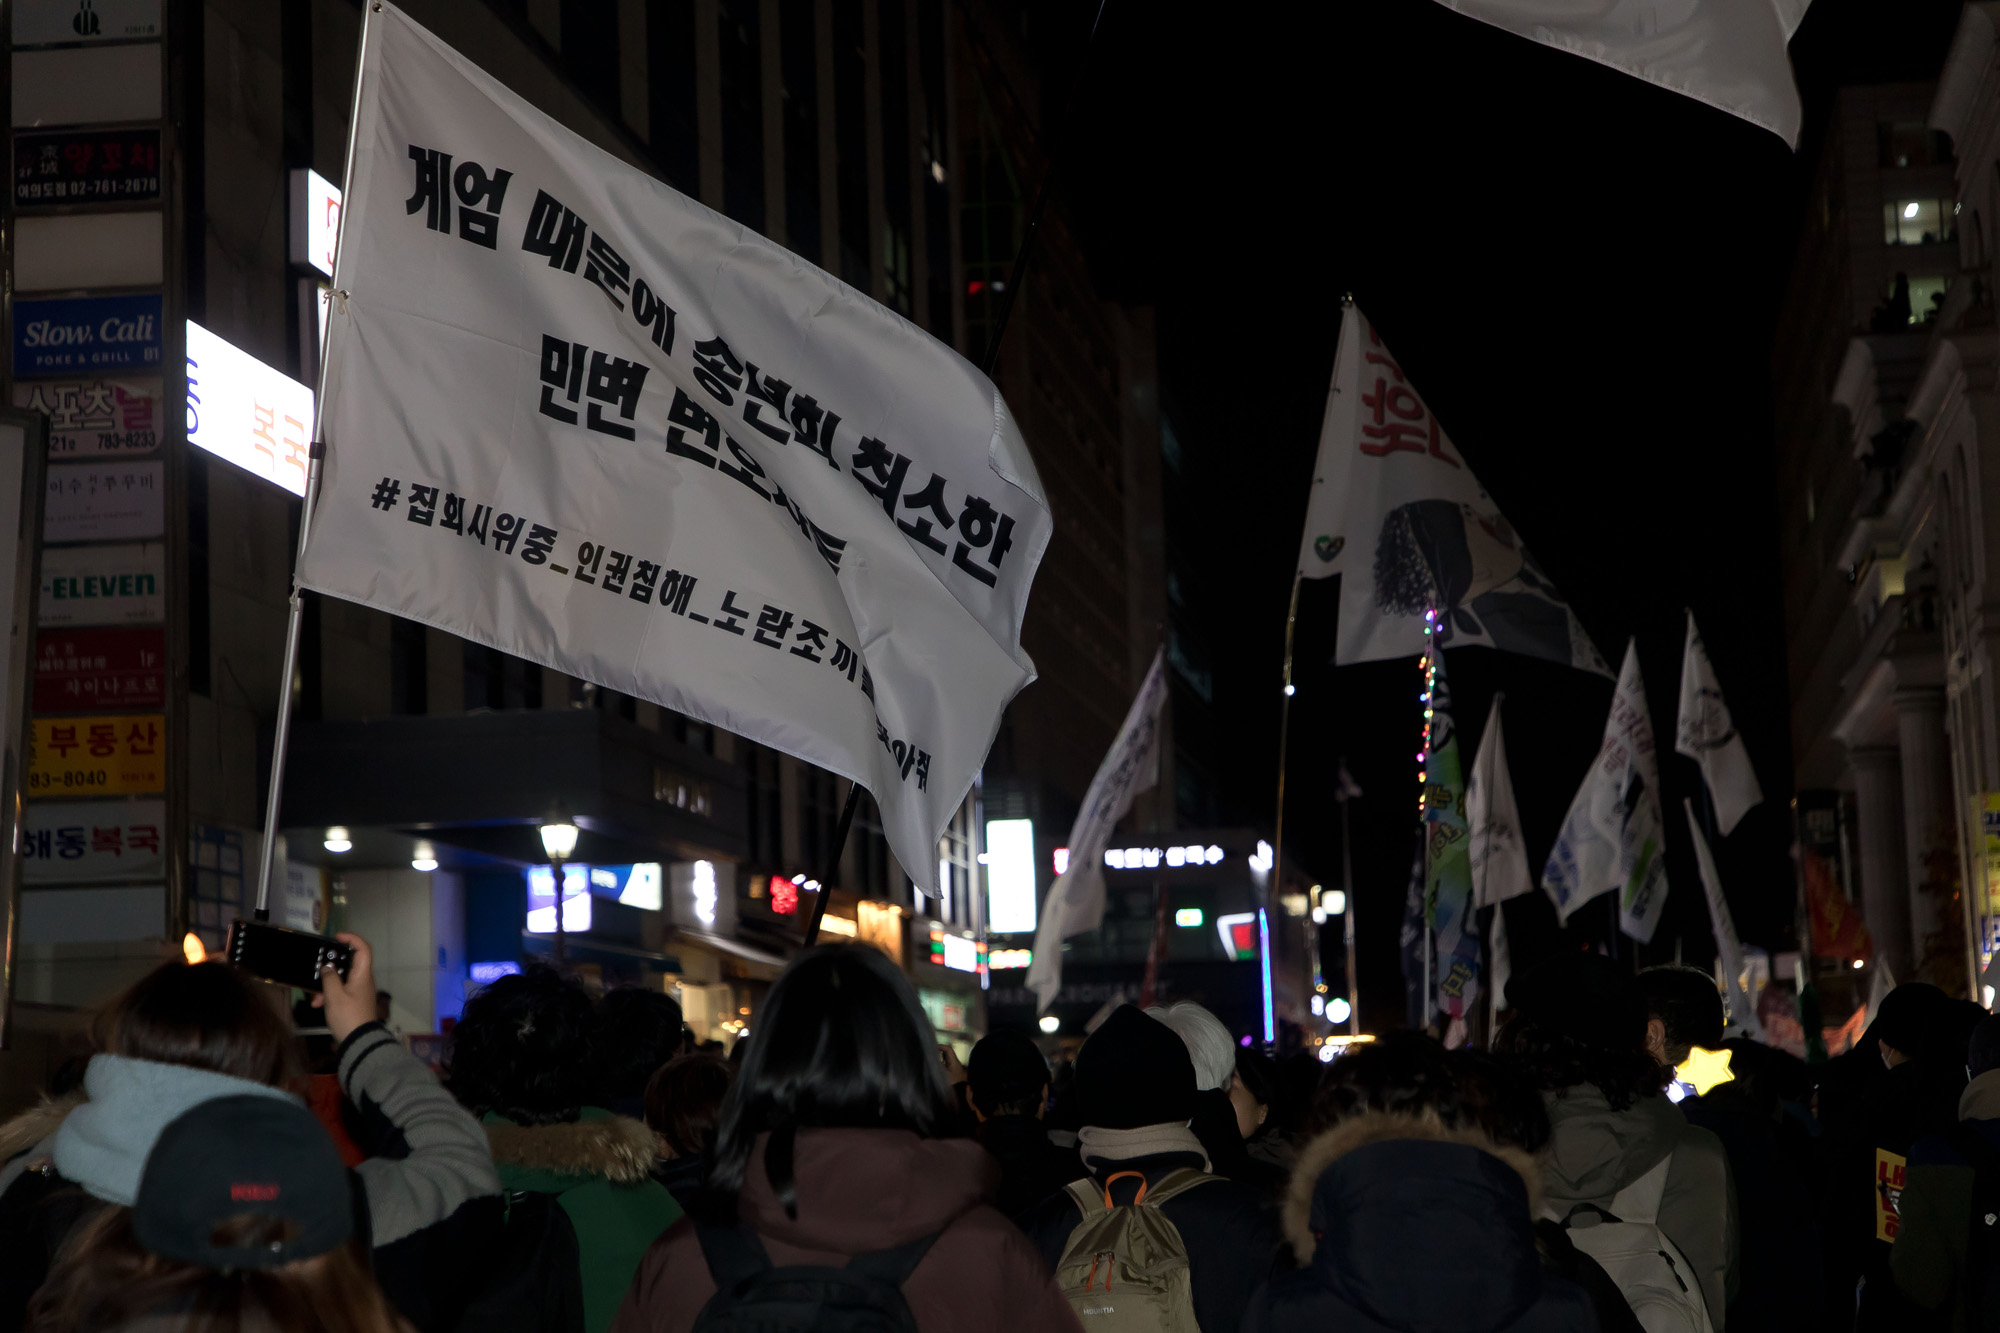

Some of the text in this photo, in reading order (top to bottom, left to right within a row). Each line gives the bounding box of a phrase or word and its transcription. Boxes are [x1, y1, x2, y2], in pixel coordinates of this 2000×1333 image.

[100, 314, 154, 343] Cali
[36, 351, 130, 366] POKE & GRILL
[405, 144, 514, 251] 계엄
[521, 188, 678, 357] 때문에
[693, 336, 842, 472] 송년회
[852, 436, 1016, 588] 취소한
[539, 333, 847, 576] 민변 변호
[48, 722, 158, 758] 부동산
[29, 770, 106, 788] 83-8040
[23, 825, 159, 859] 해동복국
